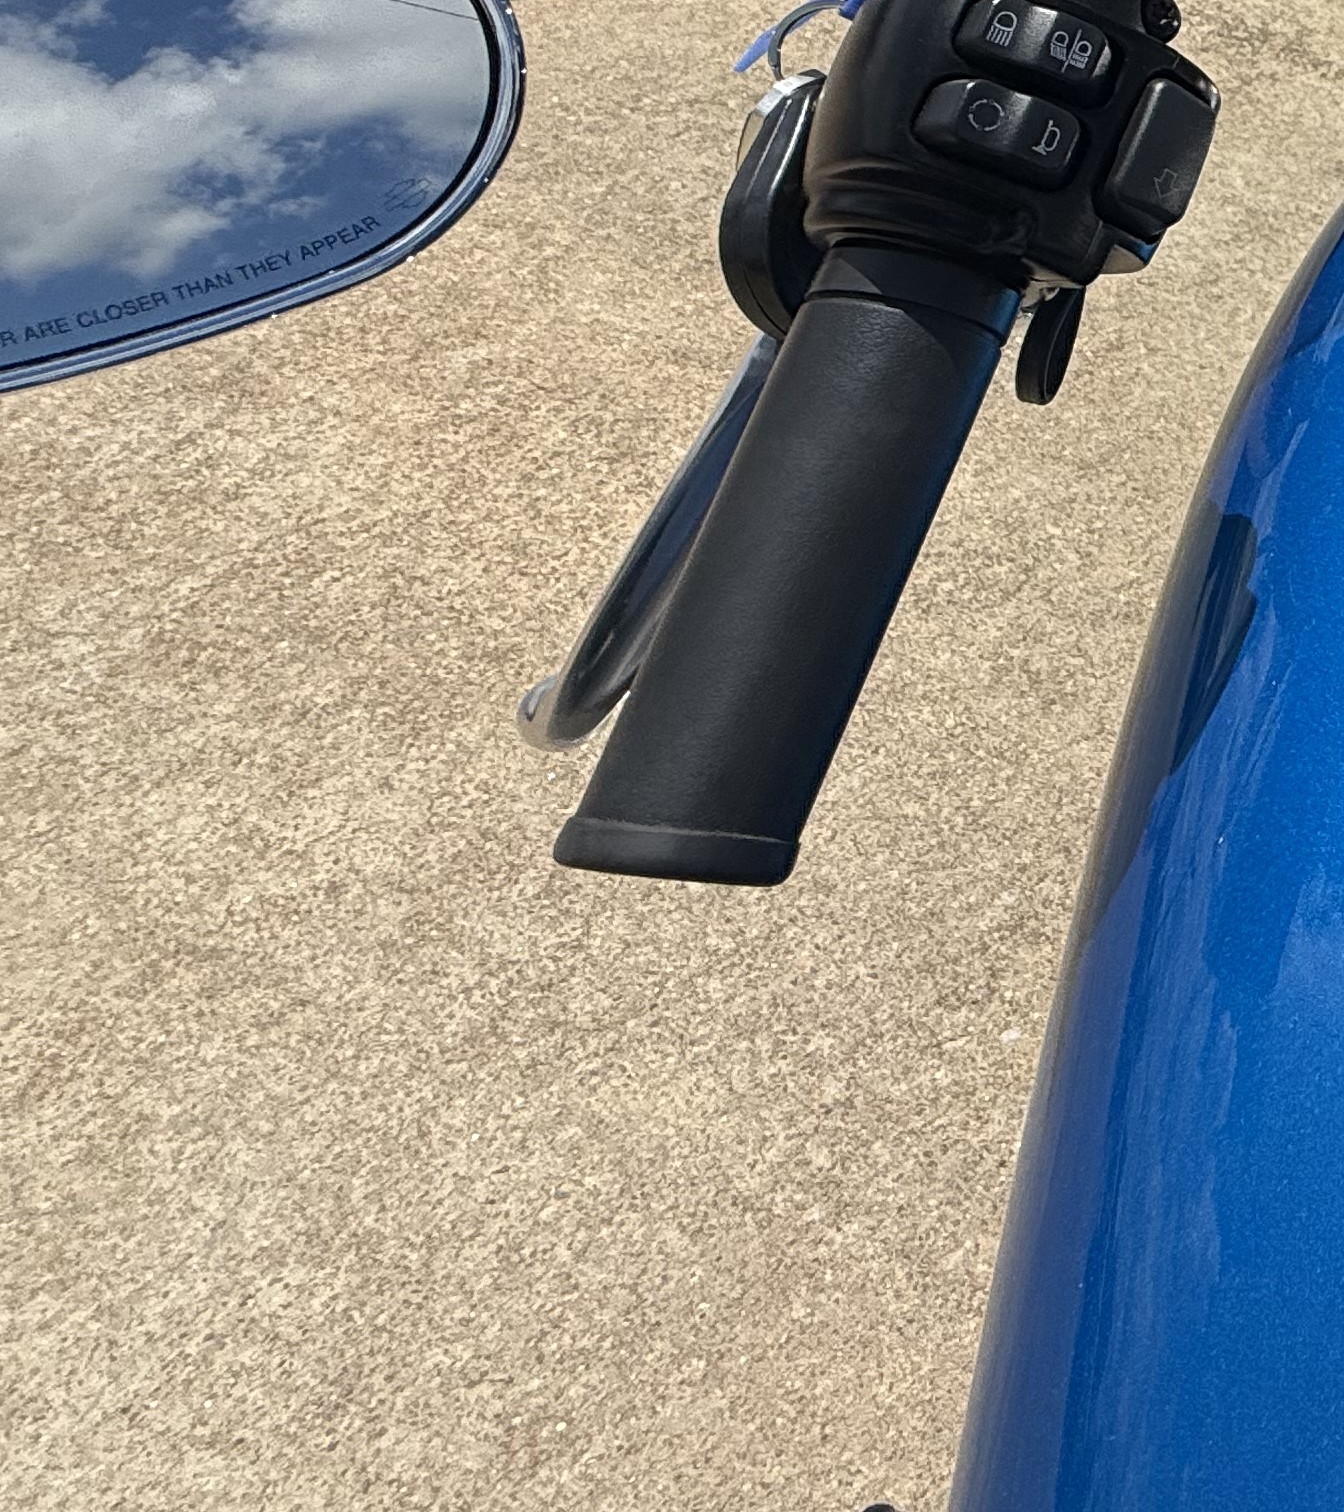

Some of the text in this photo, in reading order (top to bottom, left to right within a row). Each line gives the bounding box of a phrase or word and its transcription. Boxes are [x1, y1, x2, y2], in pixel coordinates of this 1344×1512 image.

[25, 316, 69, 342] ARE
[77, 291, 169, 328] CLOSER
[172, 272, 235, 300] THAN
[239, 249, 292, 281] THEY
[300, 215, 381, 261] APPEAR
